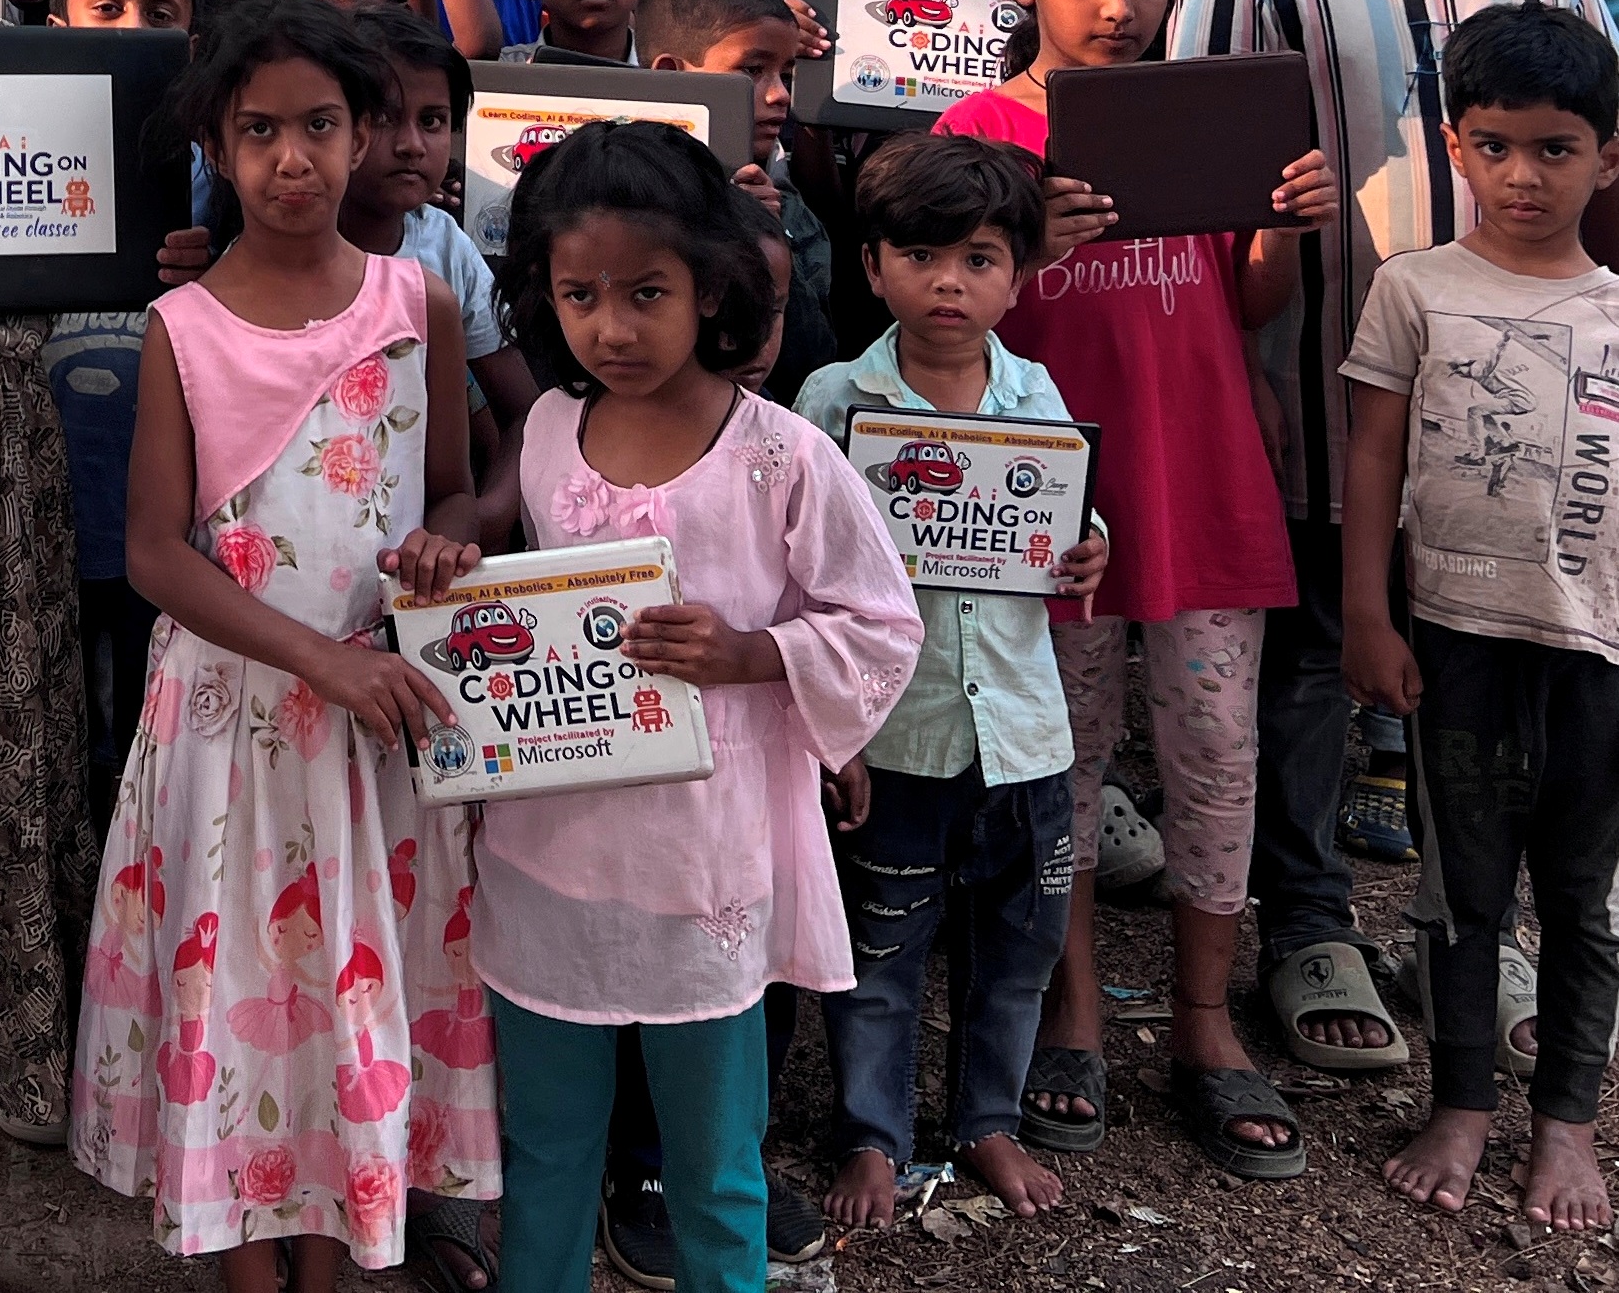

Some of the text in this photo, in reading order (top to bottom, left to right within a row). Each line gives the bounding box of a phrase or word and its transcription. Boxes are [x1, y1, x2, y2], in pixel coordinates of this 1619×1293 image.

[921, 82, 978, 99] Micros
[58, 155, 87, 171] ON
[25, 217, 78, 238] classes
[860, 425, 886, 435] Learn
[951, 432, 992, 443] Robotics
[1005, 436, 1055, 448] Absolutely
[1056, 439, 1077, 449] Free
[889, 496, 1052, 528] CODING ON
[1557, 434, 1610, 577] WORLD
[912, 523, 1024, 554] WHEEL
[922, 560, 1001, 580] Microsoft
[926, 552, 953, 562] Project
[997, 556, 1007, 565] by
[479, 569, 655, 599] AI & Robotics Absolutely Free
[576, 606, 586, 618] An
[459, 660, 616, 705] CODING
[491, 692, 632, 733] WHEEL
[517, 727, 615, 746] Project facilitated by
[517, 737, 613, 766] Microsoft
